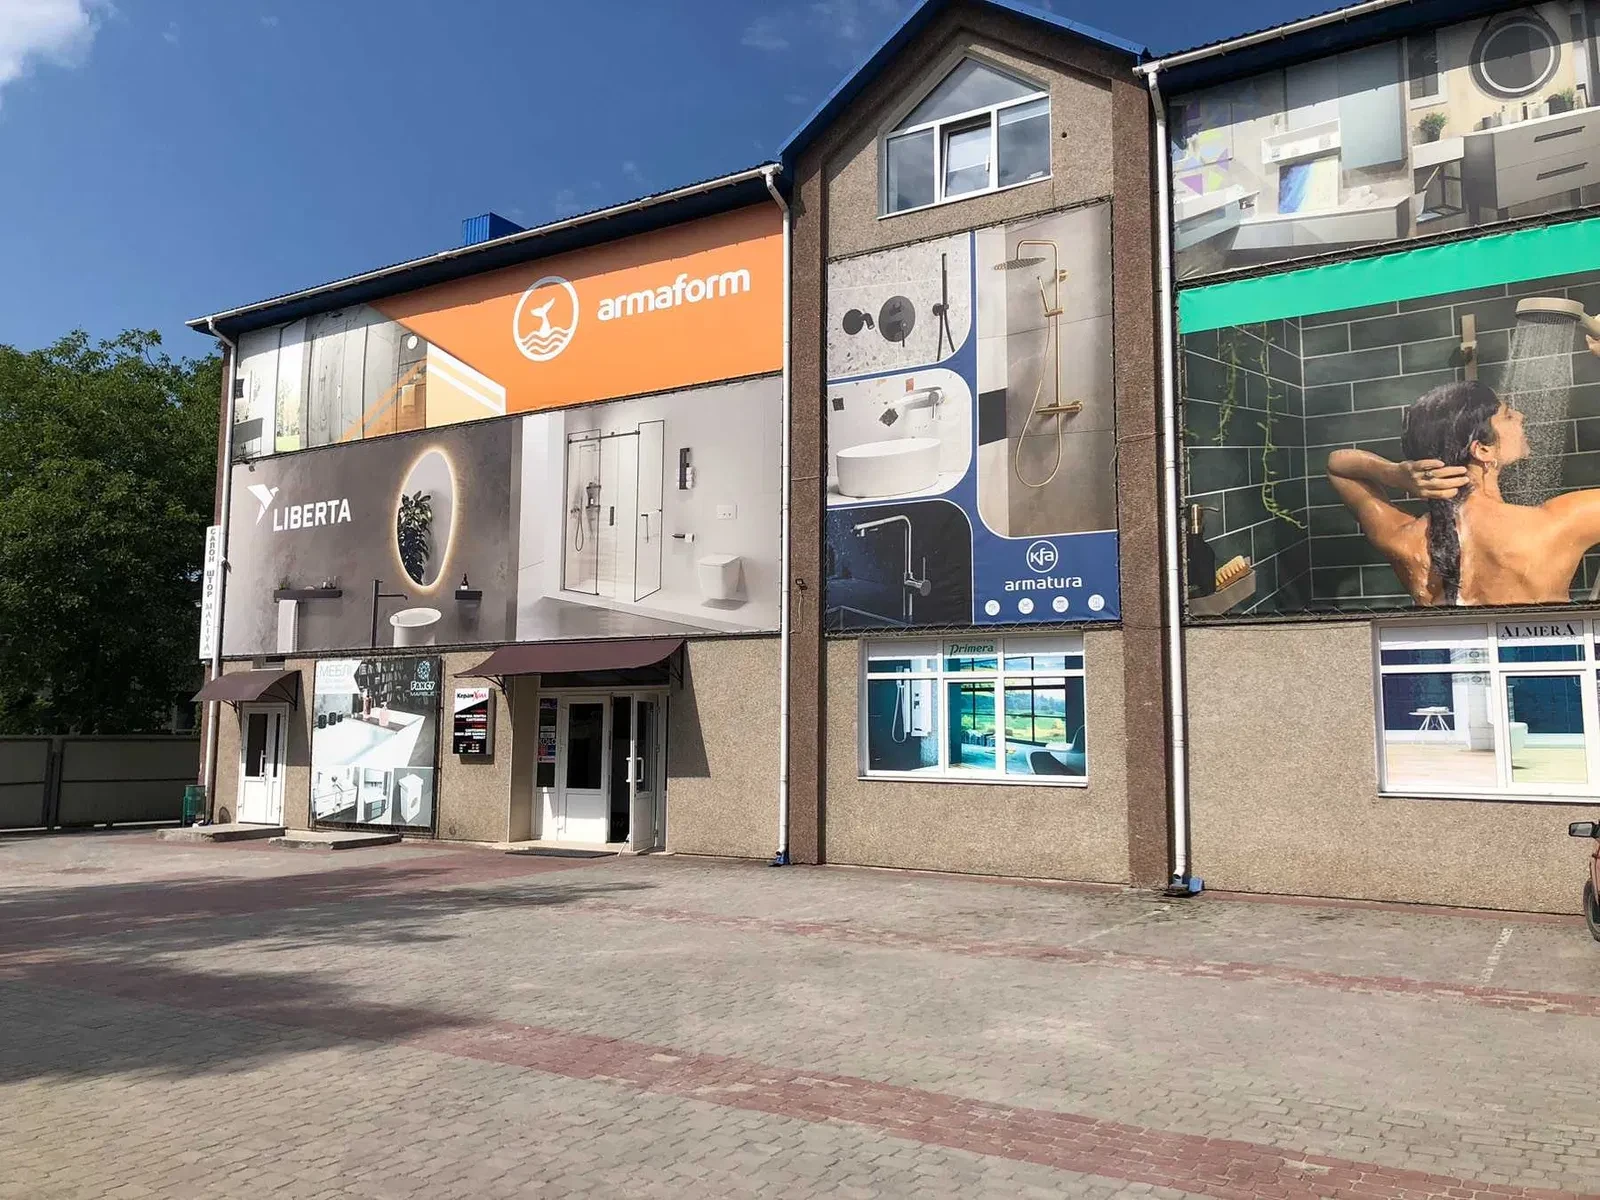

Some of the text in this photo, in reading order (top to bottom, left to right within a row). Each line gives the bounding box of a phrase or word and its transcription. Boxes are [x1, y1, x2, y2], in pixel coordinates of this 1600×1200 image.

[597, 268, 751, 321] armaform
[273, 498, 352, 532] LIBERTA
[206, 527, 217, 598] САЛОН ШТОР
[1004, 576, 1083, 592] armatura
[1501, 623, 1576, 638] ALMERA
[949, 643, 995, 657] Primera
[410, 680, 436, 691] FANCY
